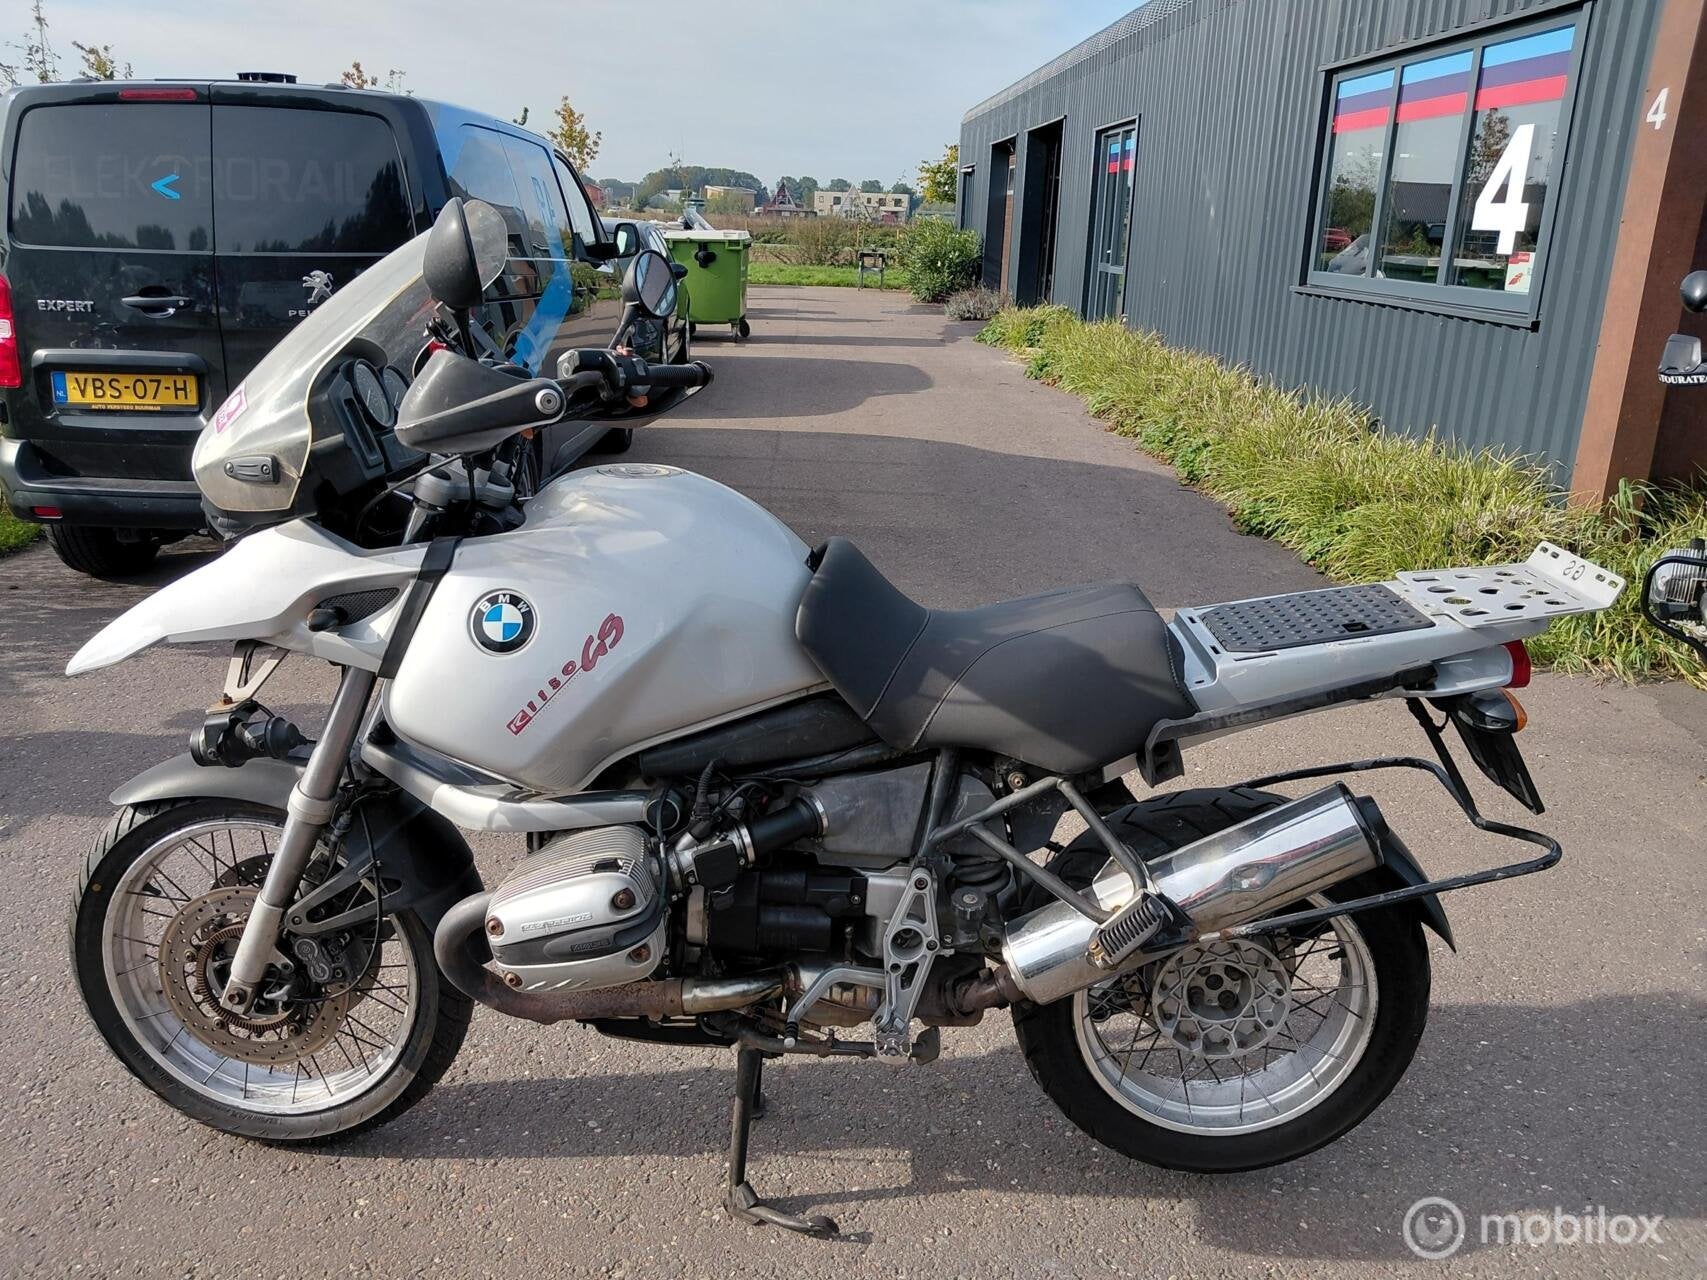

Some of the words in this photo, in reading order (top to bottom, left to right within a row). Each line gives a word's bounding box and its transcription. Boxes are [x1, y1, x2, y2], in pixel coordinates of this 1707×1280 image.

[1645, 87, 1670, 130] 4
[1471, 123, 1535, 255] 4
[37, 299, 94, 313] EXPERT
[74, 376, 189, 400] VBS-07-H
[1660, 374, 1707, 384] TOURATE
[479, 594, 531, 614] BMW
